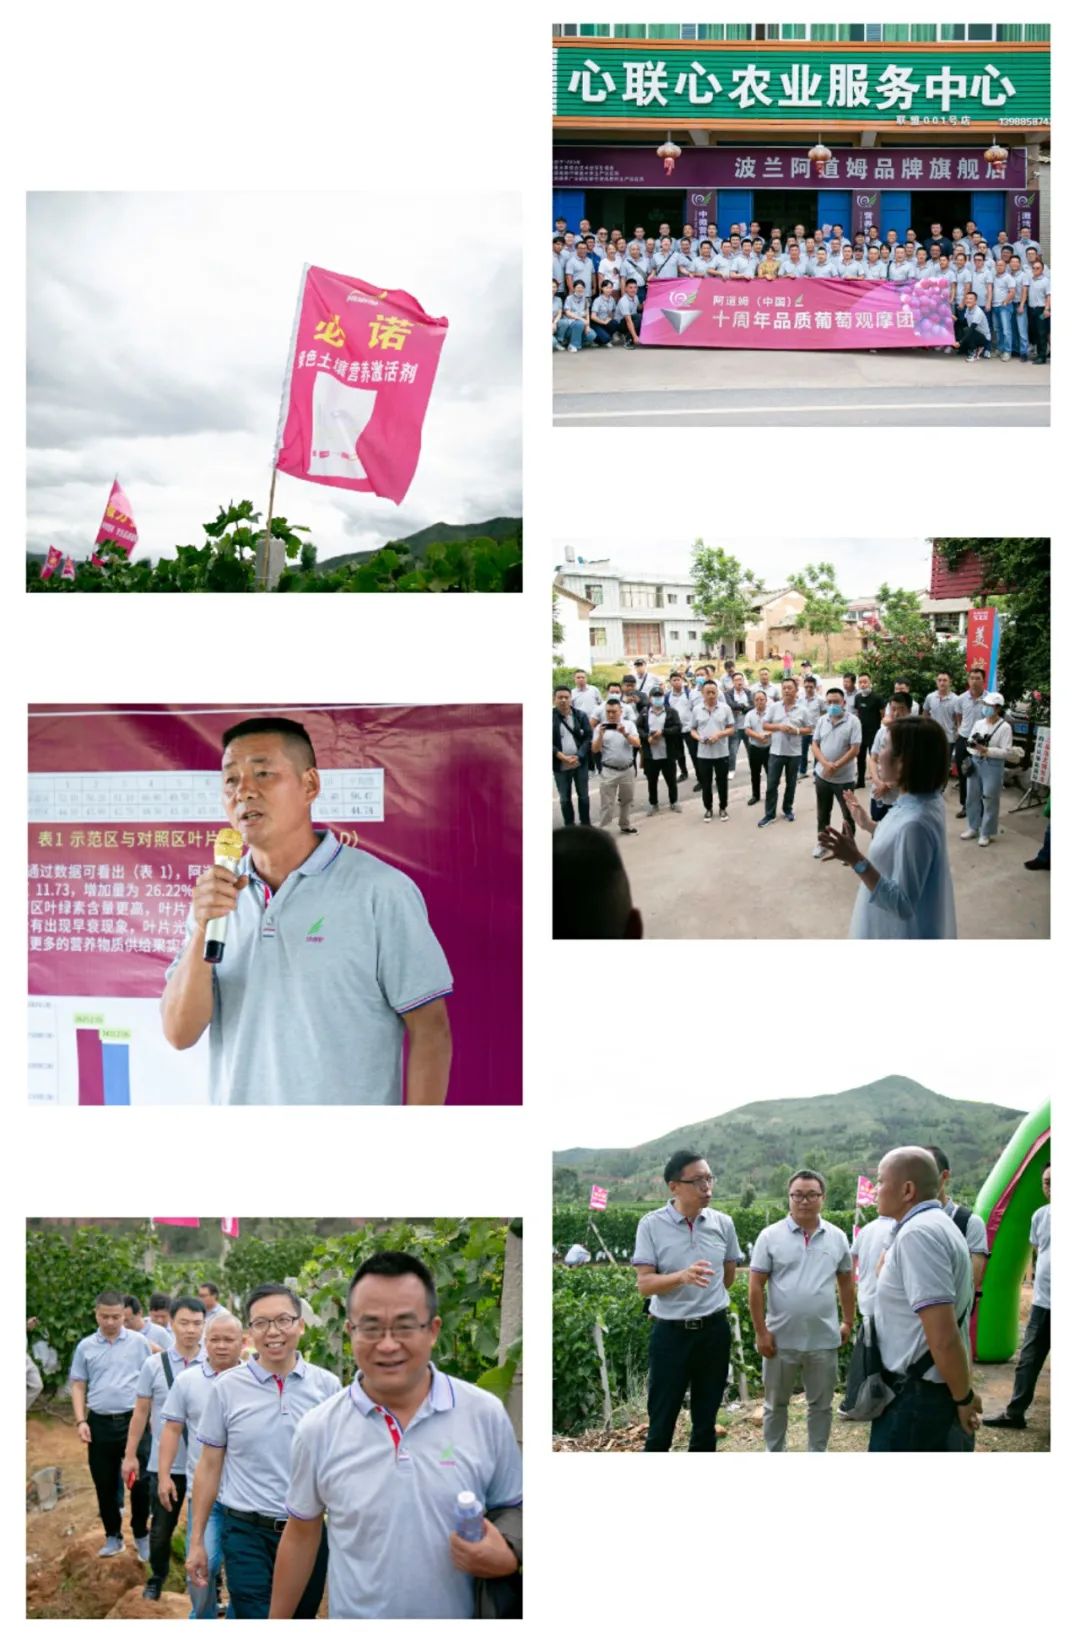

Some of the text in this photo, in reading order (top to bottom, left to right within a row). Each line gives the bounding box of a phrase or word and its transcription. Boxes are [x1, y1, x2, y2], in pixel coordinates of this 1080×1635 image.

[568, 59, 1016, 112] 心联心农业服务中心
[712, 310, 915, 329] 十周年品质葡萄观摩团
[38, 831, 63, 847] 表1
[30, 900, 192, 917] 区叶绿素含量更高，叶片
[30, 935, 185, 952] 更多的营养物质供给果实
